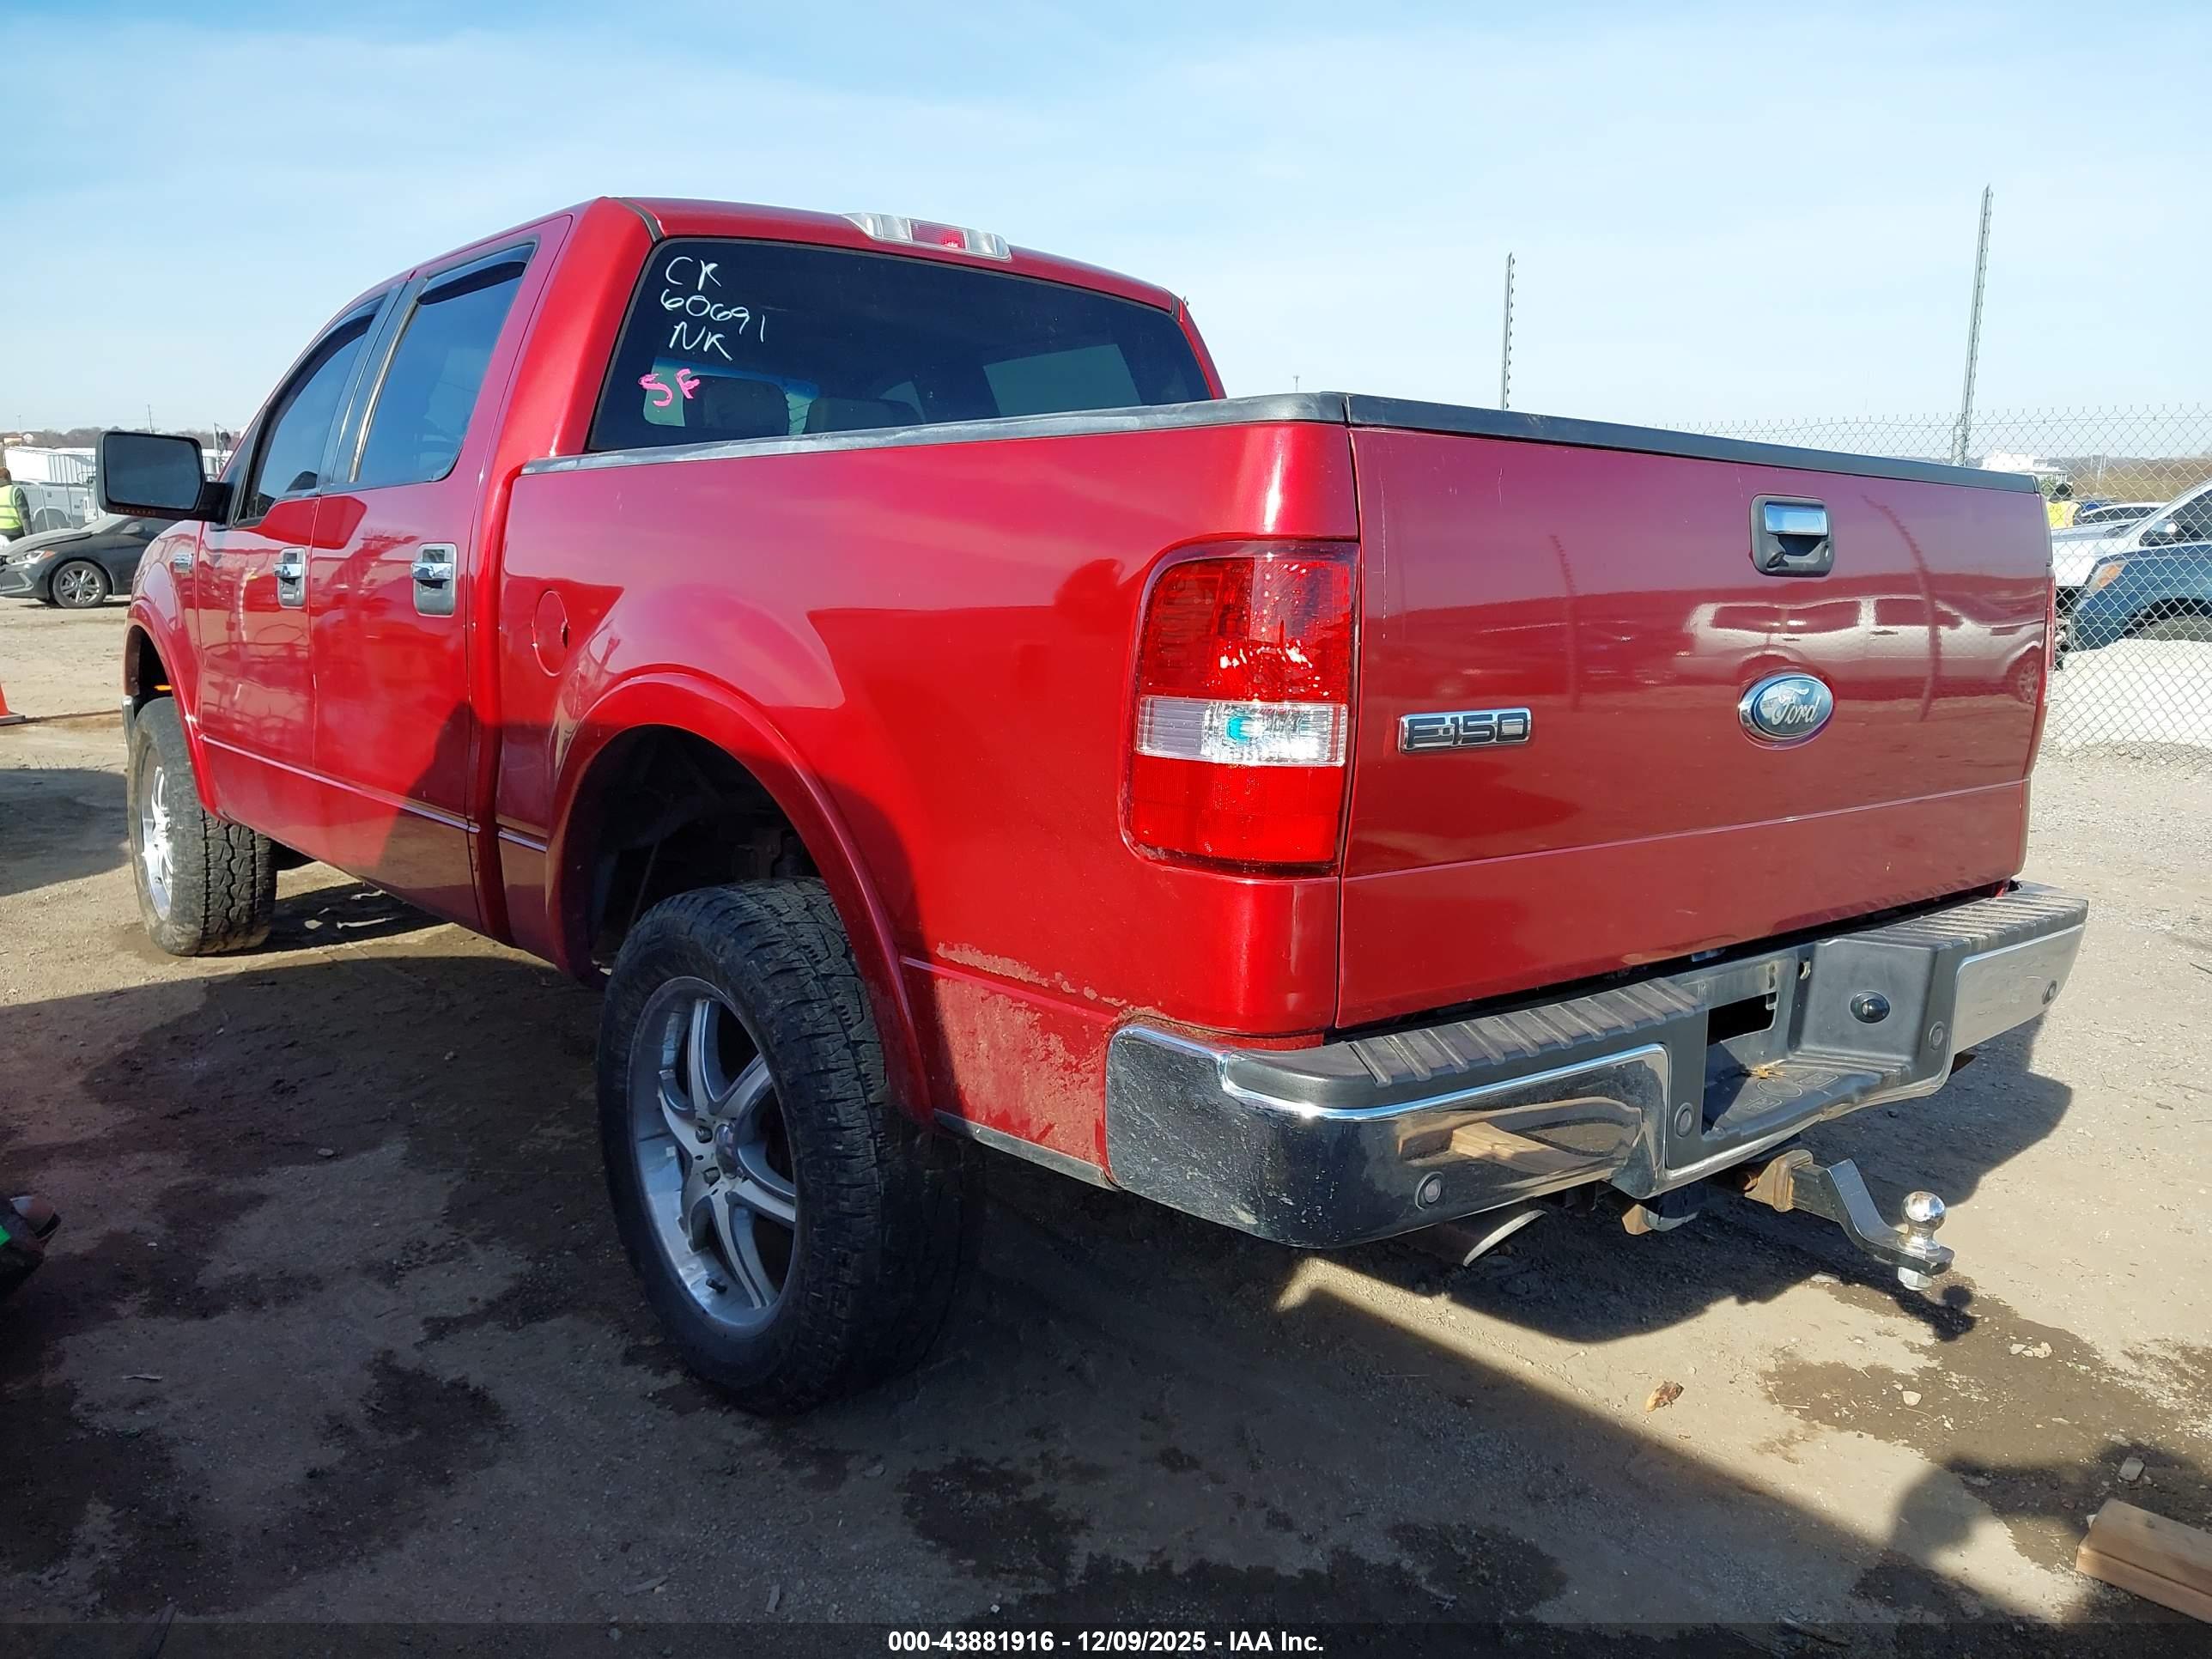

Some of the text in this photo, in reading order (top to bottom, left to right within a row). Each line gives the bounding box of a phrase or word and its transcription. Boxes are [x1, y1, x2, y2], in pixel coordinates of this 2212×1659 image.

[659, 289, 766, 343] 60691
[668, 321, 733, 362] NK
[1771, 684, 1821, 726] Ford
